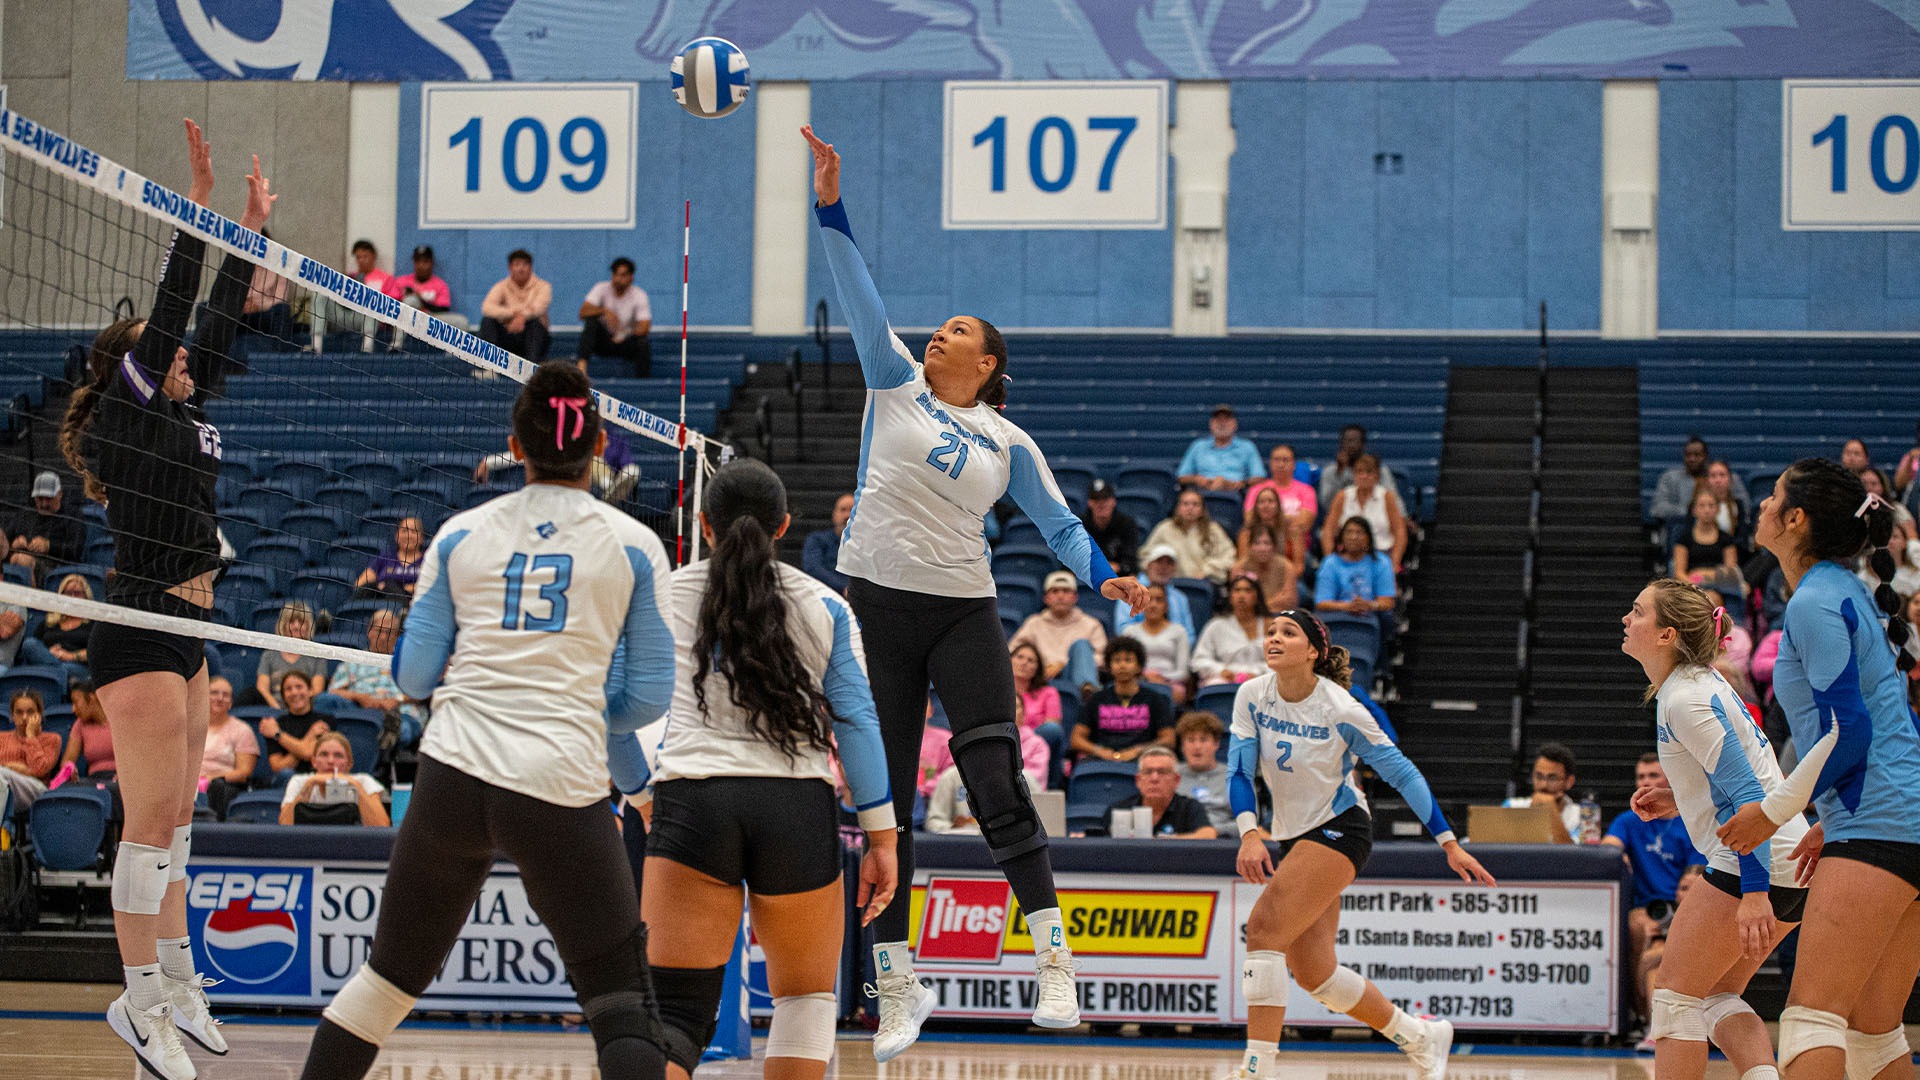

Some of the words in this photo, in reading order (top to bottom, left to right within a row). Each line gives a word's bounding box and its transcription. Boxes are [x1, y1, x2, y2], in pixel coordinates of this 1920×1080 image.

[448, 116, 609, 193] 109
[973, 116, 1139, 192] 107
[142, 181, 197, 227] SONOMA
[197, 207, 268, 259] SEAWOLVES
[299, 257, 344, 296] SONOMA
[344, 276, 401, 320] SEAWOLVES
[926, 432, 968, 480] 21
[502, 552, 573, 633] 13
[1276, 741, 1294, 773] 2
[929, 889, 1003, 939] Tires
[1069, 907, 1199, 939] SCHWAB
[1341, 893, 1384, 911] nert
[1389, 892, 1433, 912] Park
[1451, 893, 1538, 914] 585-3111
[1413, 930, 1453, 947] Rosa
[1457, 930, 1492, 948] Ave)
[1510, 929, 1603, 949] 578-5334
[1501, 963, 1590, 985] 539-1700
[957, 978, 1012, 1008] TIRE
[1103, 981, 1217, 1013] PROMISE
[1428, 996, 1513, 1017] 837-7913
